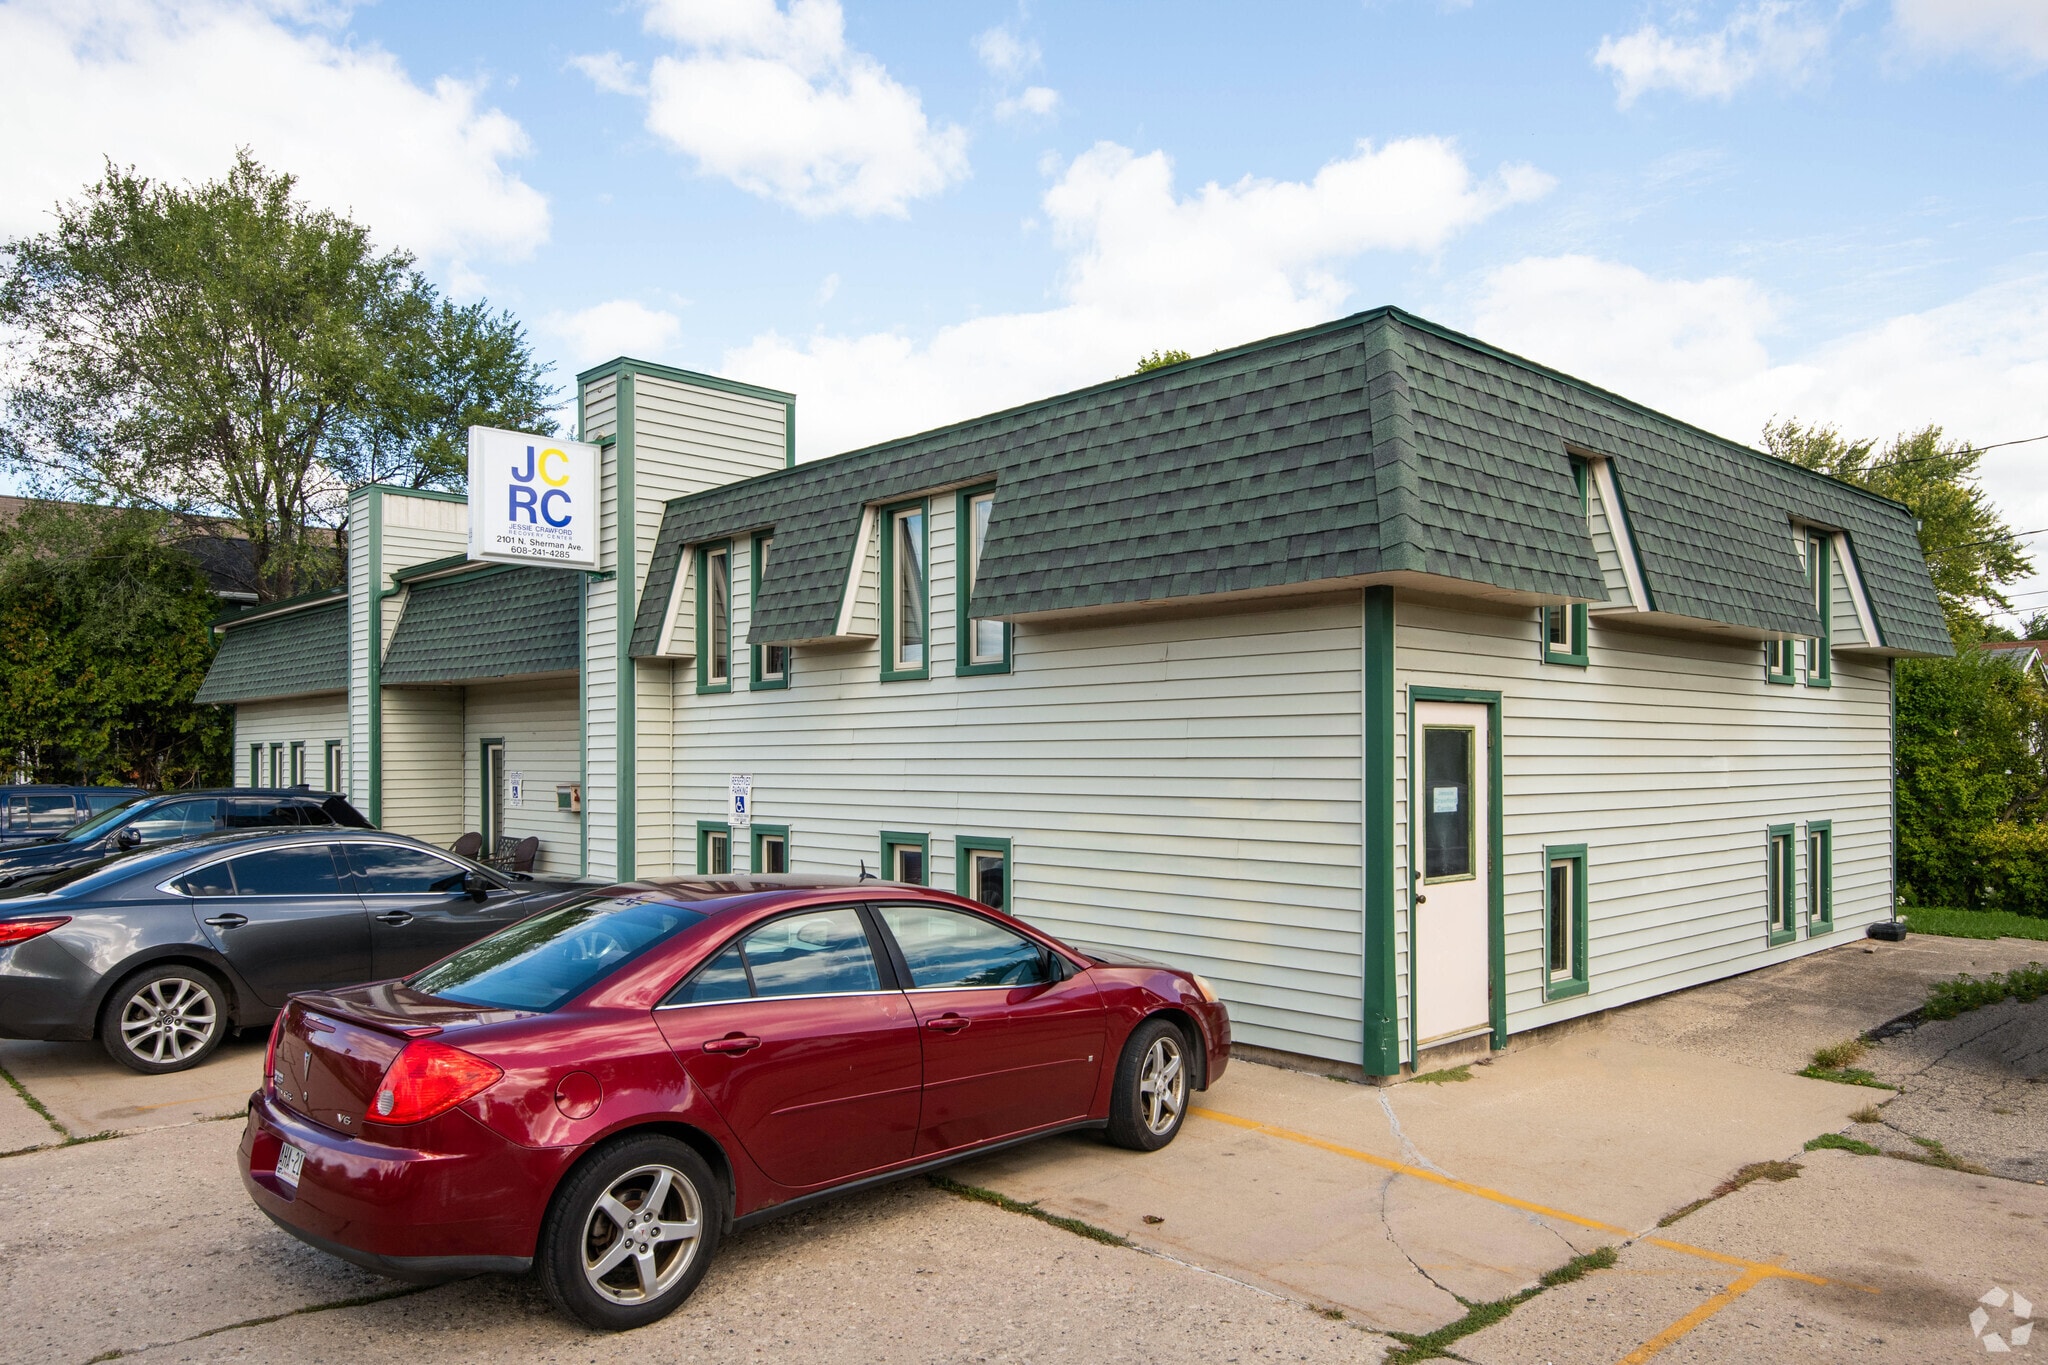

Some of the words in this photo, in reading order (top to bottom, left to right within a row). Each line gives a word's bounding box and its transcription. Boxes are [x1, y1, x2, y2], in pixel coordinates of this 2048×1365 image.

[509, 523, 533, 532] JESSIE
[535, 525, 573, 536] CRAWFORD
[496, 535, 515, 544] 2101
[529, 538, 565, 549] Sherman
[567, 543, 584, 551] Ave.
[546, 533, 573, 541] CENTER
[510, 545, 570, 558] 608-241-4285
[731, 776, 751, 786] RESERVED
[731, 785, 749, 796] PARKING
[336, 1113, 352, 1125] V6
